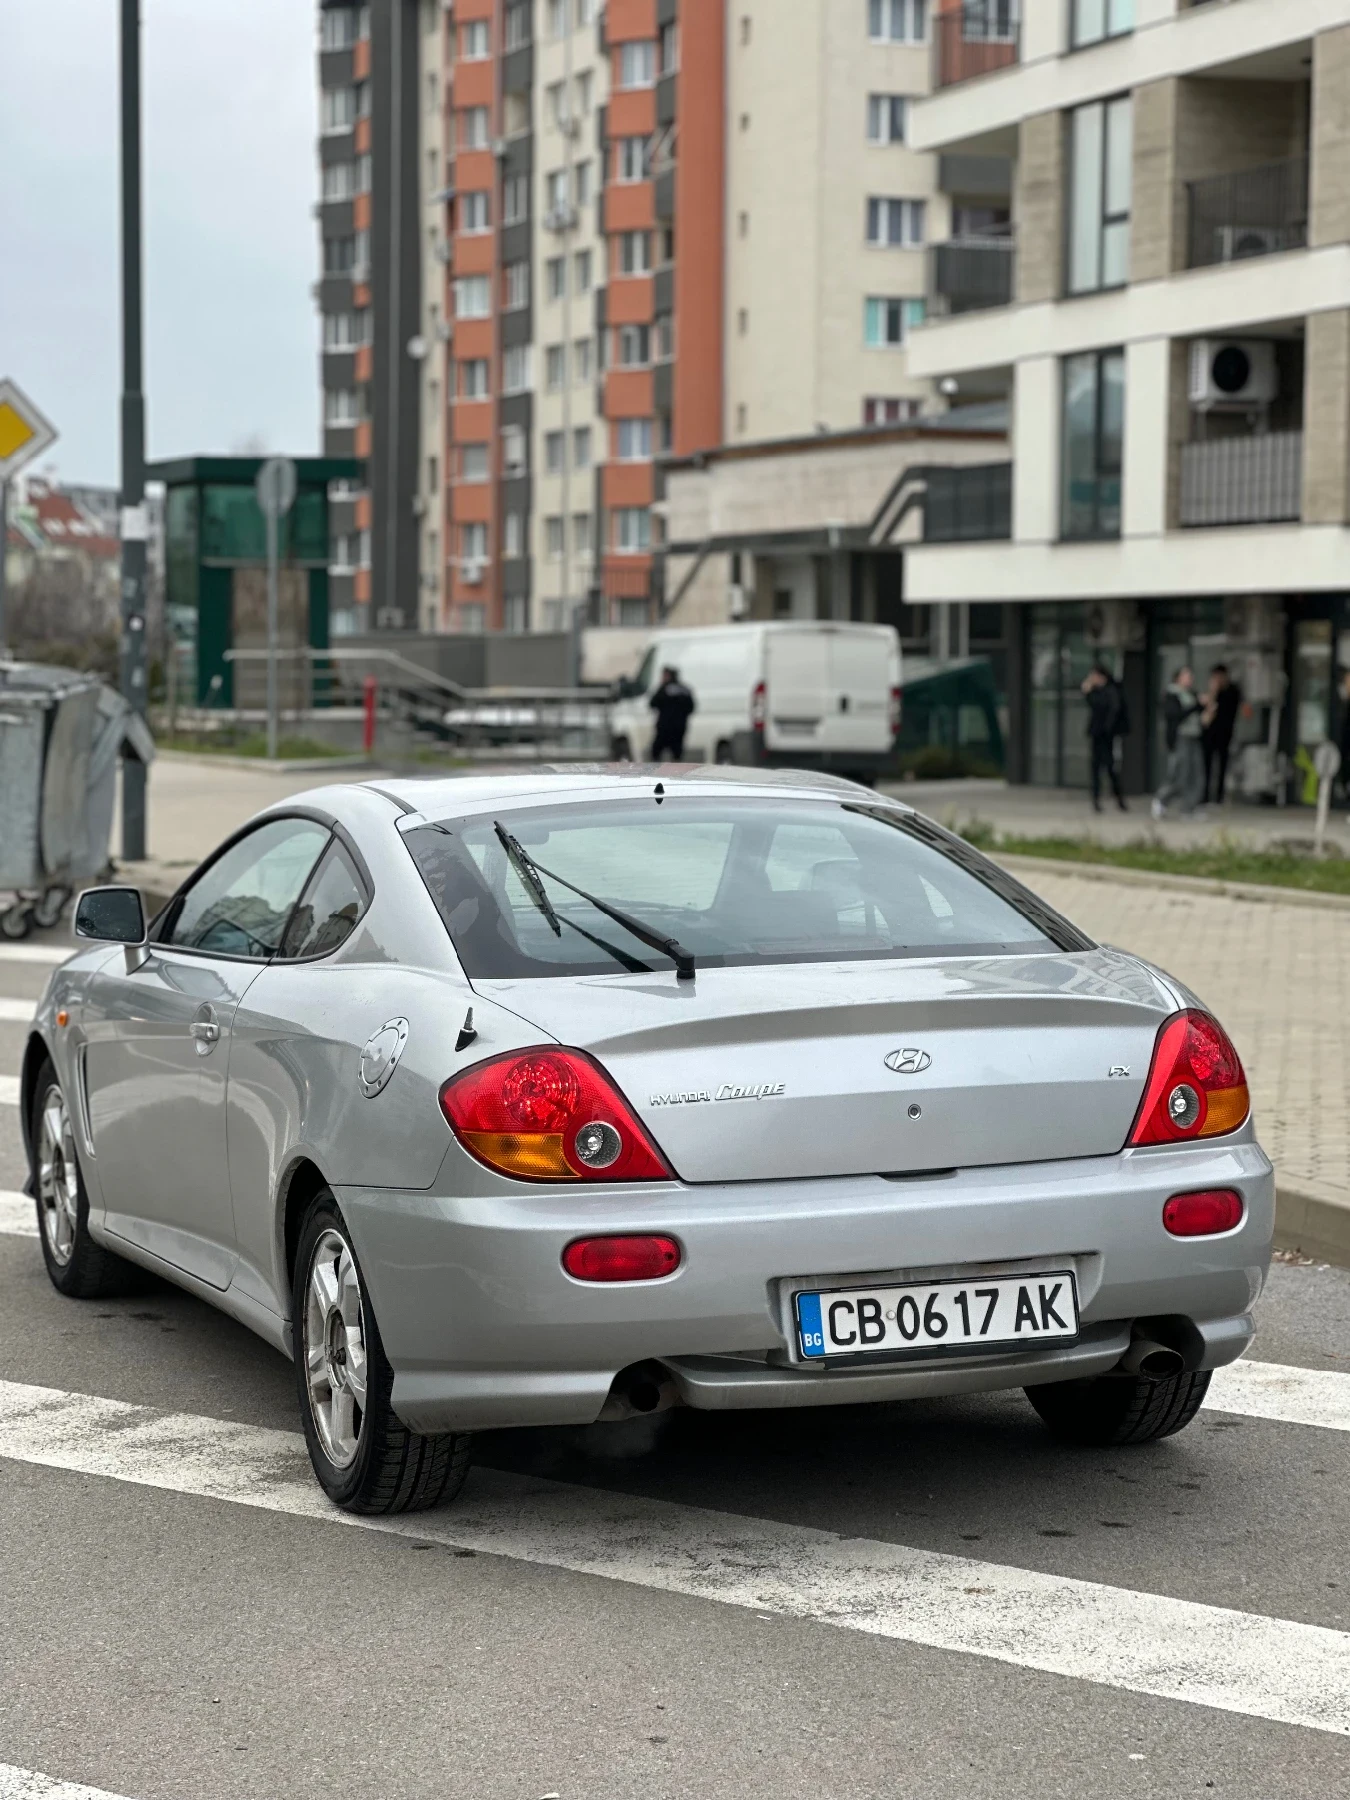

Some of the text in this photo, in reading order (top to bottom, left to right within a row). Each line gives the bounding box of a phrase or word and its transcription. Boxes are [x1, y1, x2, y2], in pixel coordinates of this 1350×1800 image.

[1108, 1065, 1130, 1077] FX
[650, 1090, 711, 1106] HYUNDAI
[828, 1283, 1068, 1346] CB 0617 AK
[804, 1331, 823, 1347] BG
